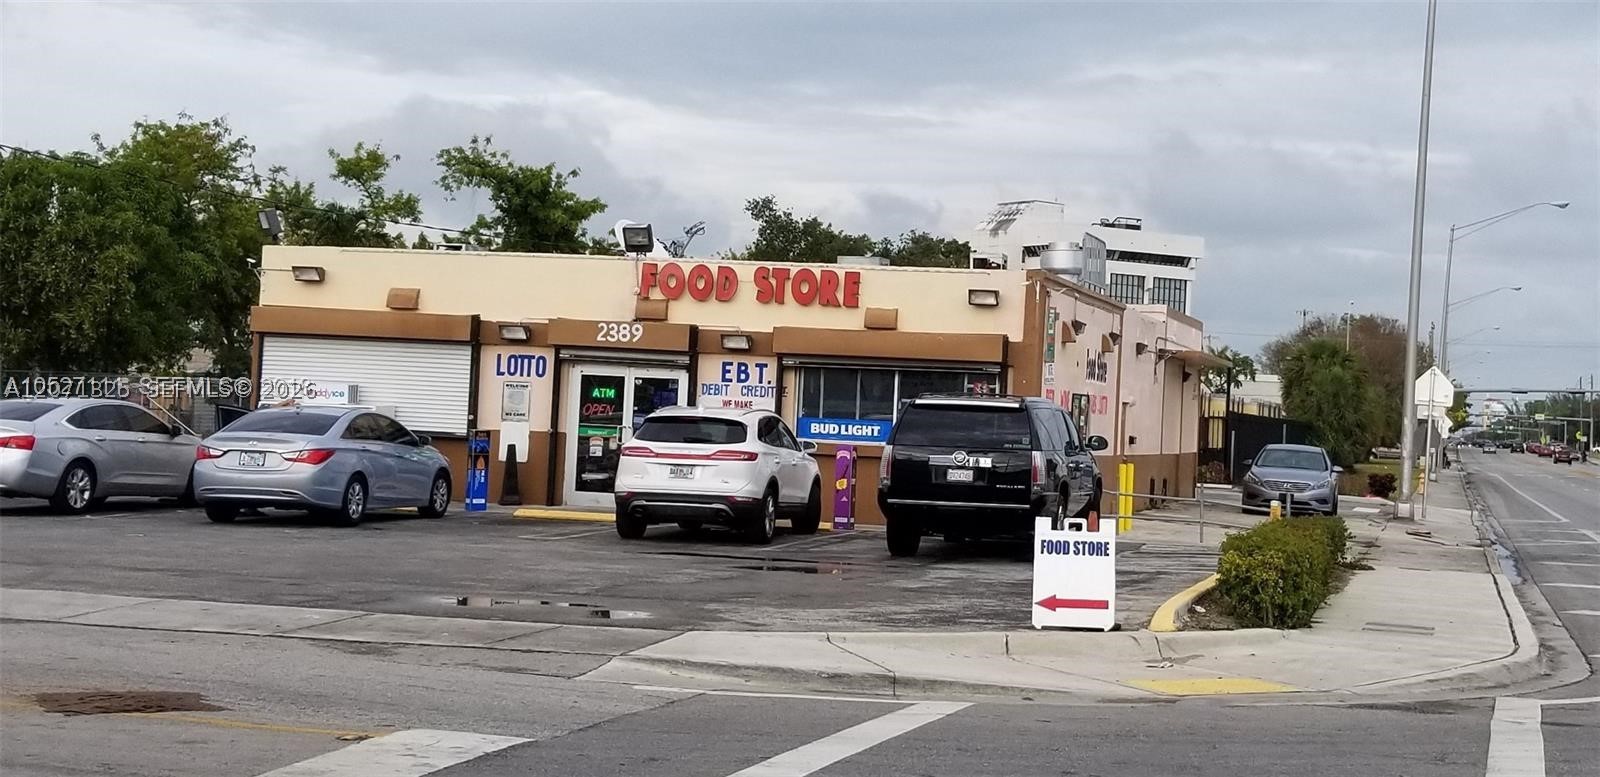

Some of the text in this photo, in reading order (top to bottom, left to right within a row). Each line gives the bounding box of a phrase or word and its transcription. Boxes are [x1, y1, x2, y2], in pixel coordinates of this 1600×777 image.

[640, 262, 862, 308] FOOD STORE
[596, 322, 644, 342] 2389
[496, 353, 548, 378] LOTTO
[592, 388, 616, 398] ATM
[701, 383, 731, 396] DEBIT
[740, 385, 777, 398] CREDIT
[582, 403, 616, 416] OPEN
[722, 400, 753, 410] WE MAKE
[810, 423, 881, 437] BUD LIGHT
[1040, 539, 1110, 557] FOOD STORE
